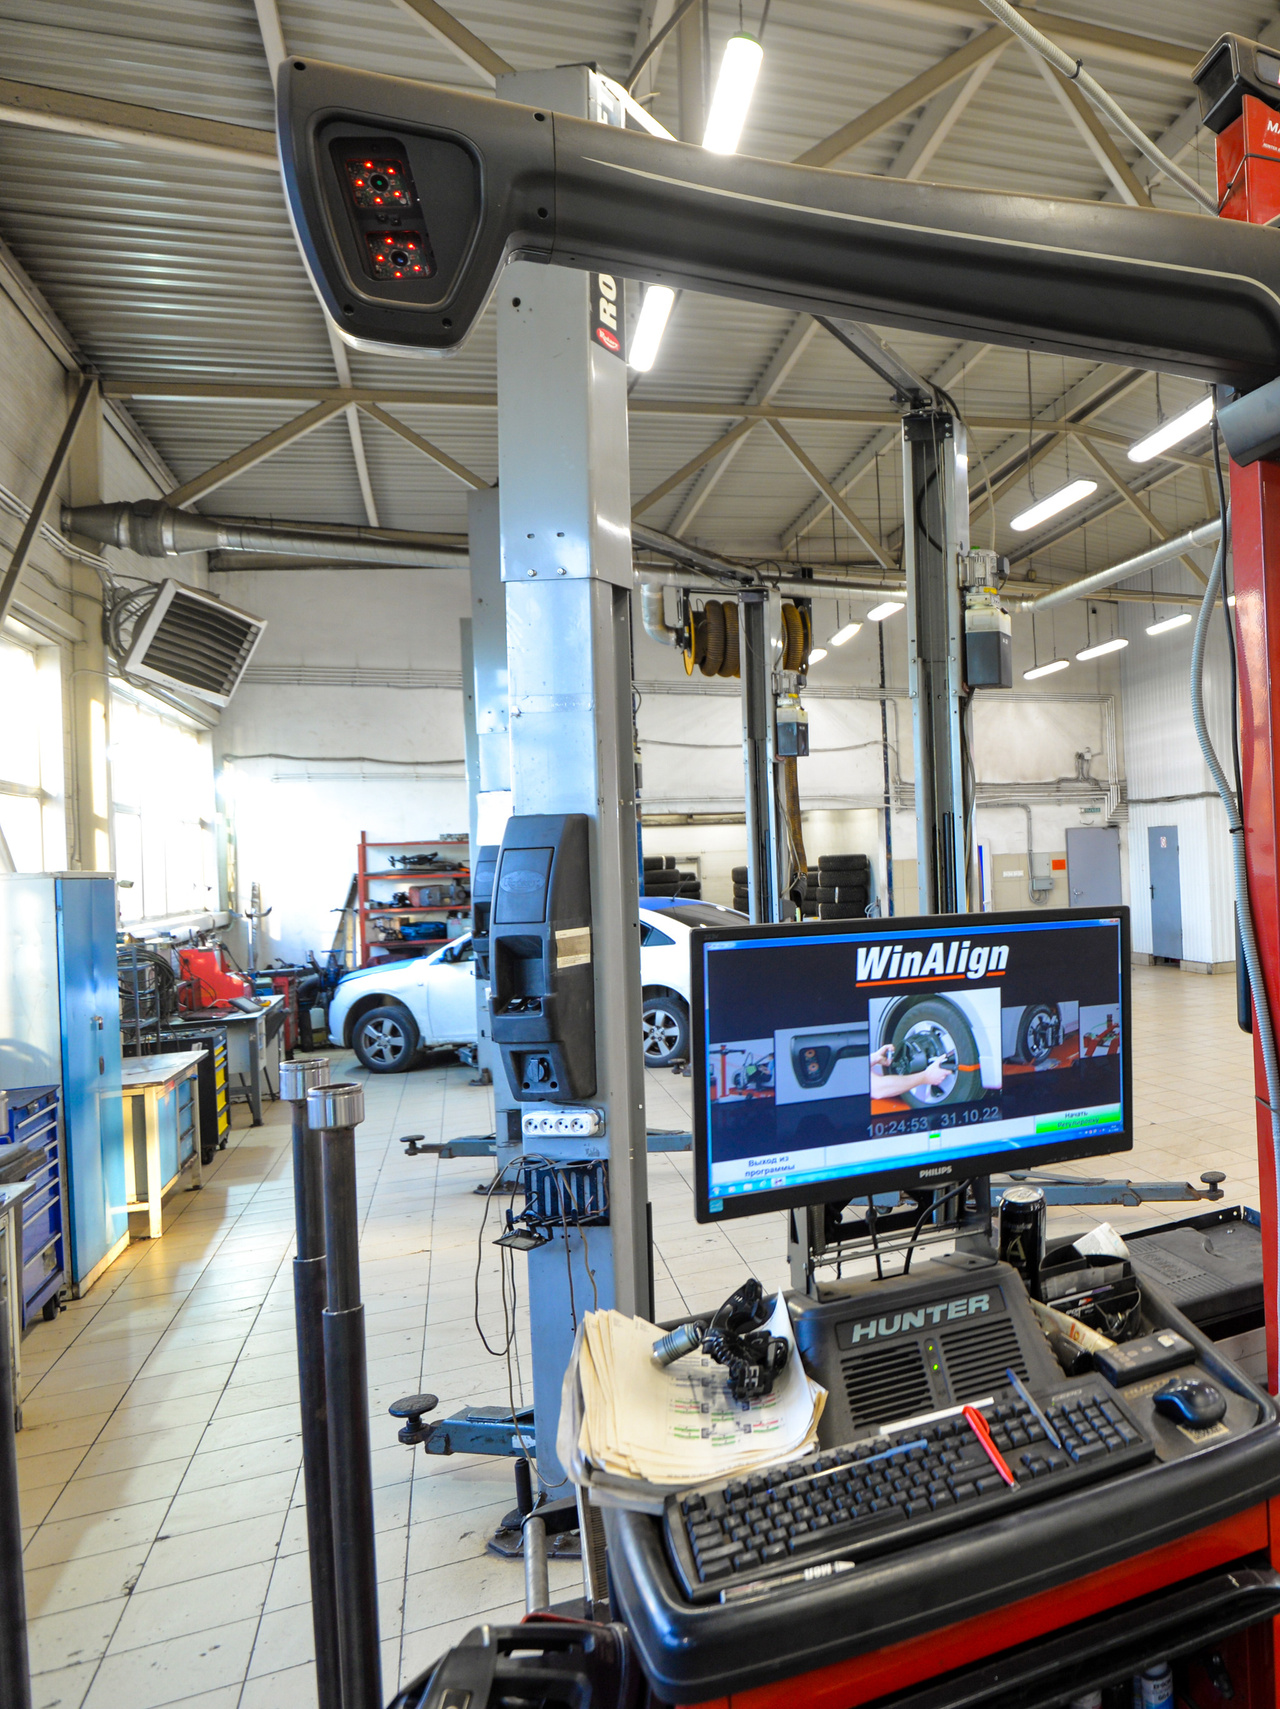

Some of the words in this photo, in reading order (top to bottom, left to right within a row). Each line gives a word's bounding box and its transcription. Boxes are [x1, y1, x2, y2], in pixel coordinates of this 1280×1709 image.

[856, 940, 1010, 981] WinAlign
[866, 1115, 929, 1138] 10:24:53
[940, 1106, 1000, 1128] 31.10.22
[744, 1164, 796, 1178] программы
[748, 1157, 777, 1168] Выход
[779, 1155, 790, 1163] из
[918, 1165, 953, 1179] PHILIPS
[852, 1293, 991, 1344] HUNTER
